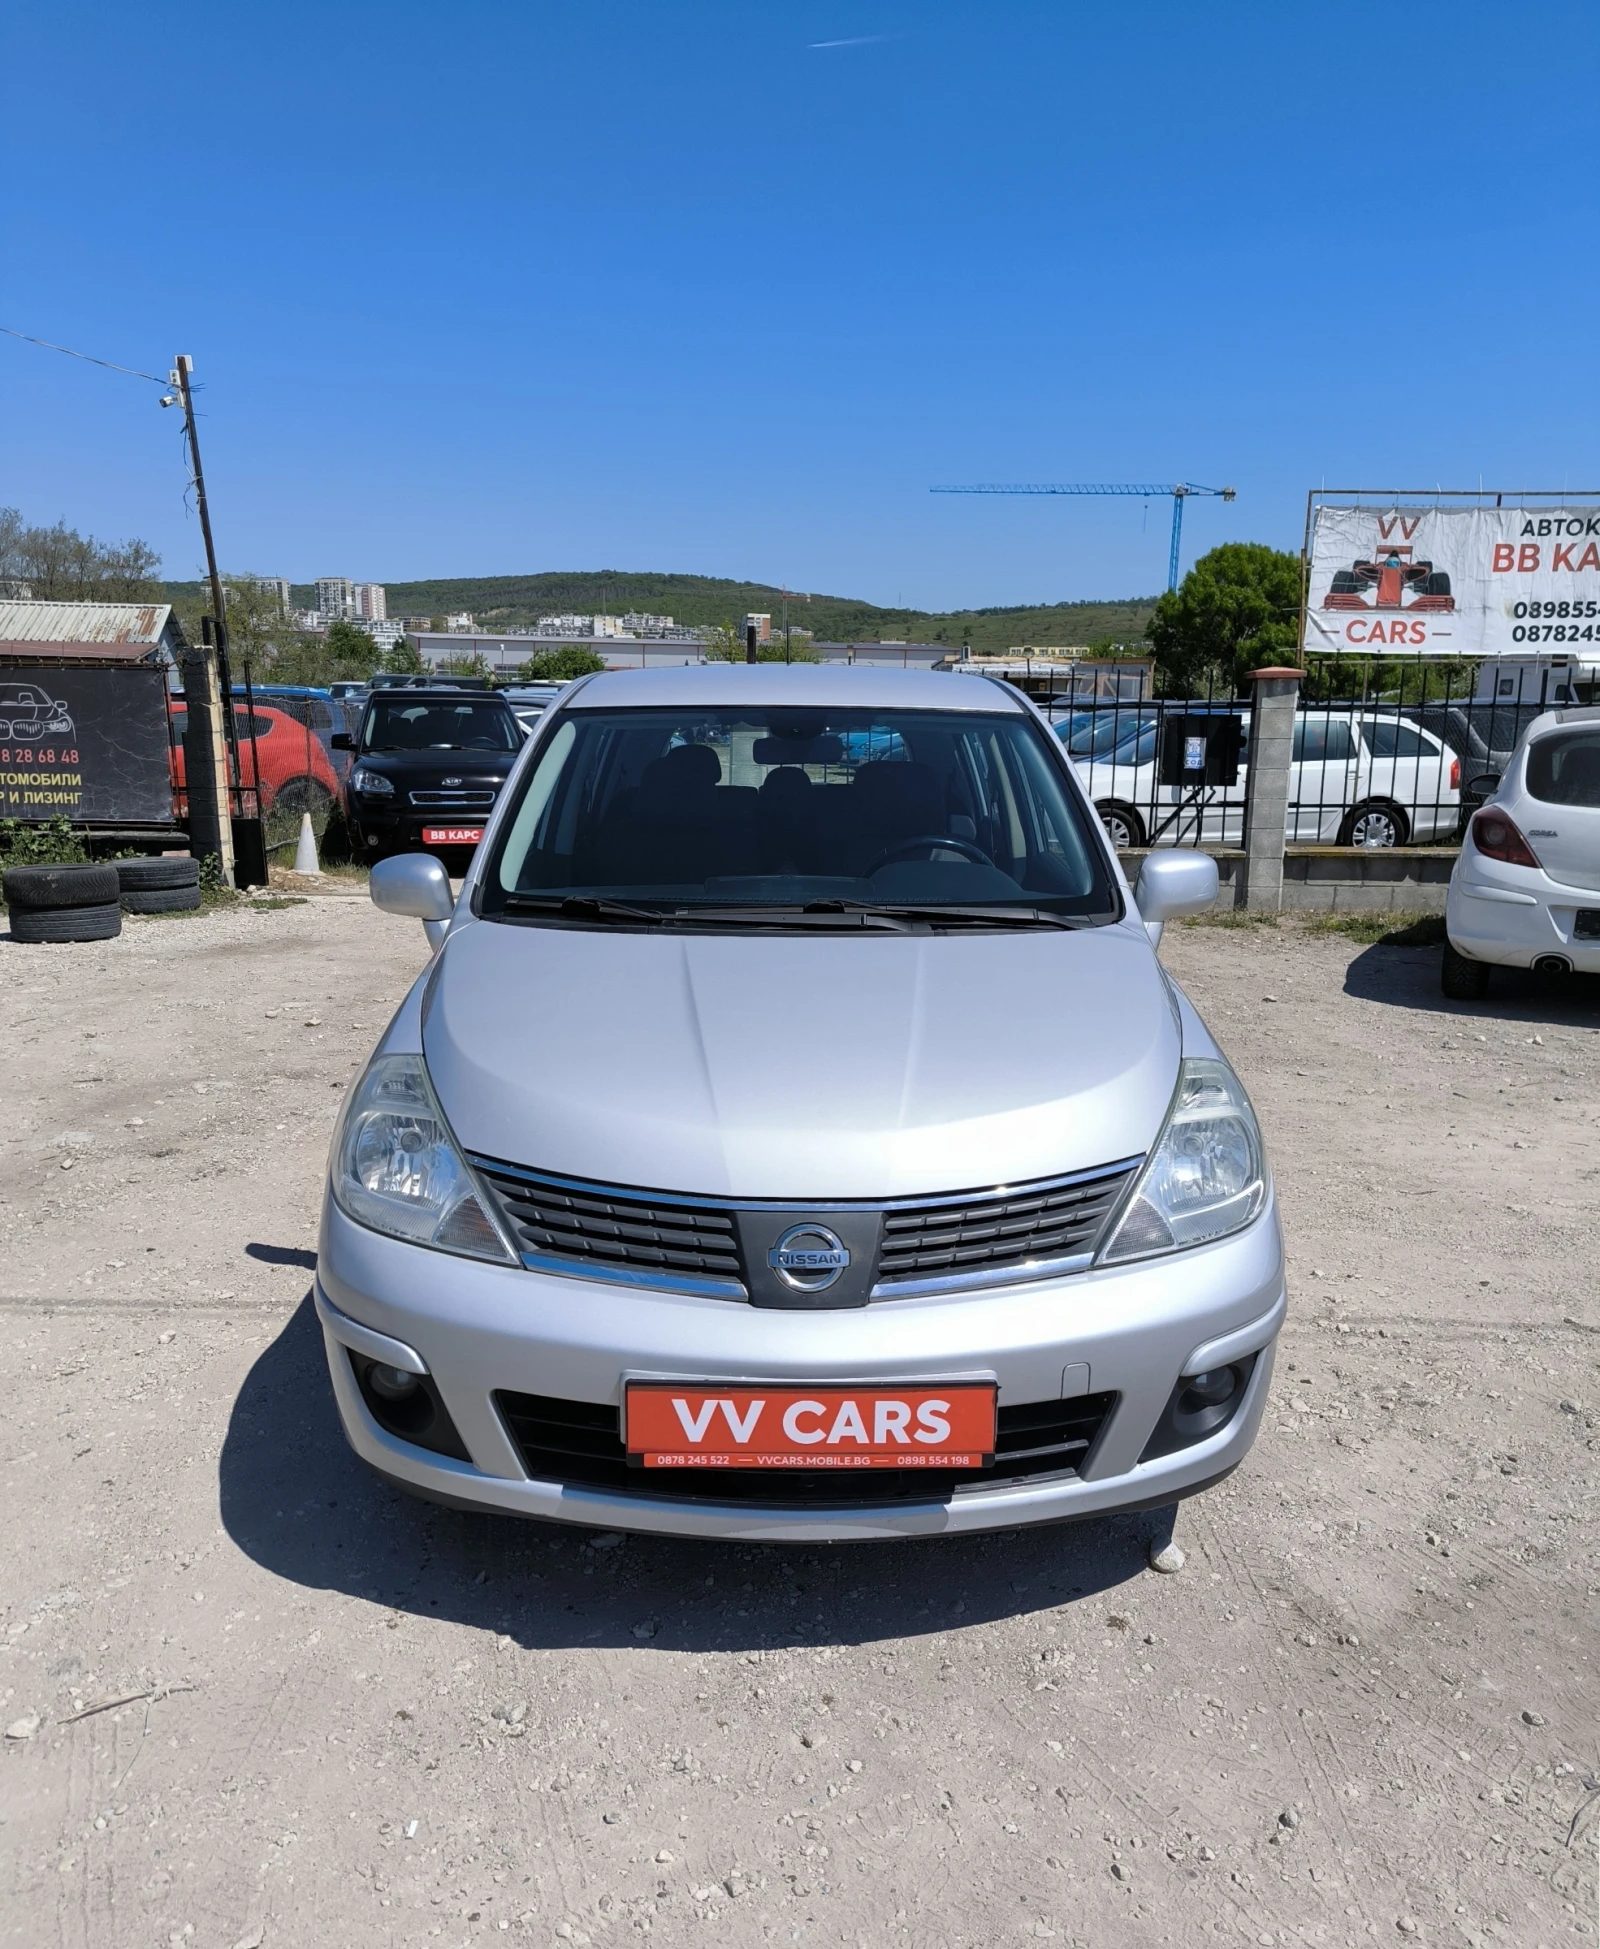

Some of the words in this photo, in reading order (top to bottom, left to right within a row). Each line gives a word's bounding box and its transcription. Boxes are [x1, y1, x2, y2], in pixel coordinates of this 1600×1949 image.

[1377, 516, 1421, 540] VV
[1513, 601, 1600, 619] 089855
[1346, 619, 1426, 645] CARS
[15, 749, 33, 763] 28
[38, 749, 55, 763] 68
[61, 750, 79, 763] 48
[9, 792, 19, 803] И
[24, 792, 82, 804] ЛИЗИНГ
[777, 1254, 842, 1265] NISSAN
[671, 1399, 766, 1443] VV
[782, 1400, 951, 1444] CARS
[657, 1455, 685, 1465] 0878
[687, 1455, 708, 1465] 245
[709, 1455, 730, 1465] 522
[756, 1455, 871, 1466] VVCARS.MOBILE.BG
[897, 1456, 926, 1465] 0898
[928, 1456, 948, 1465] 554
[950, 1456, 970, 1465] 198
